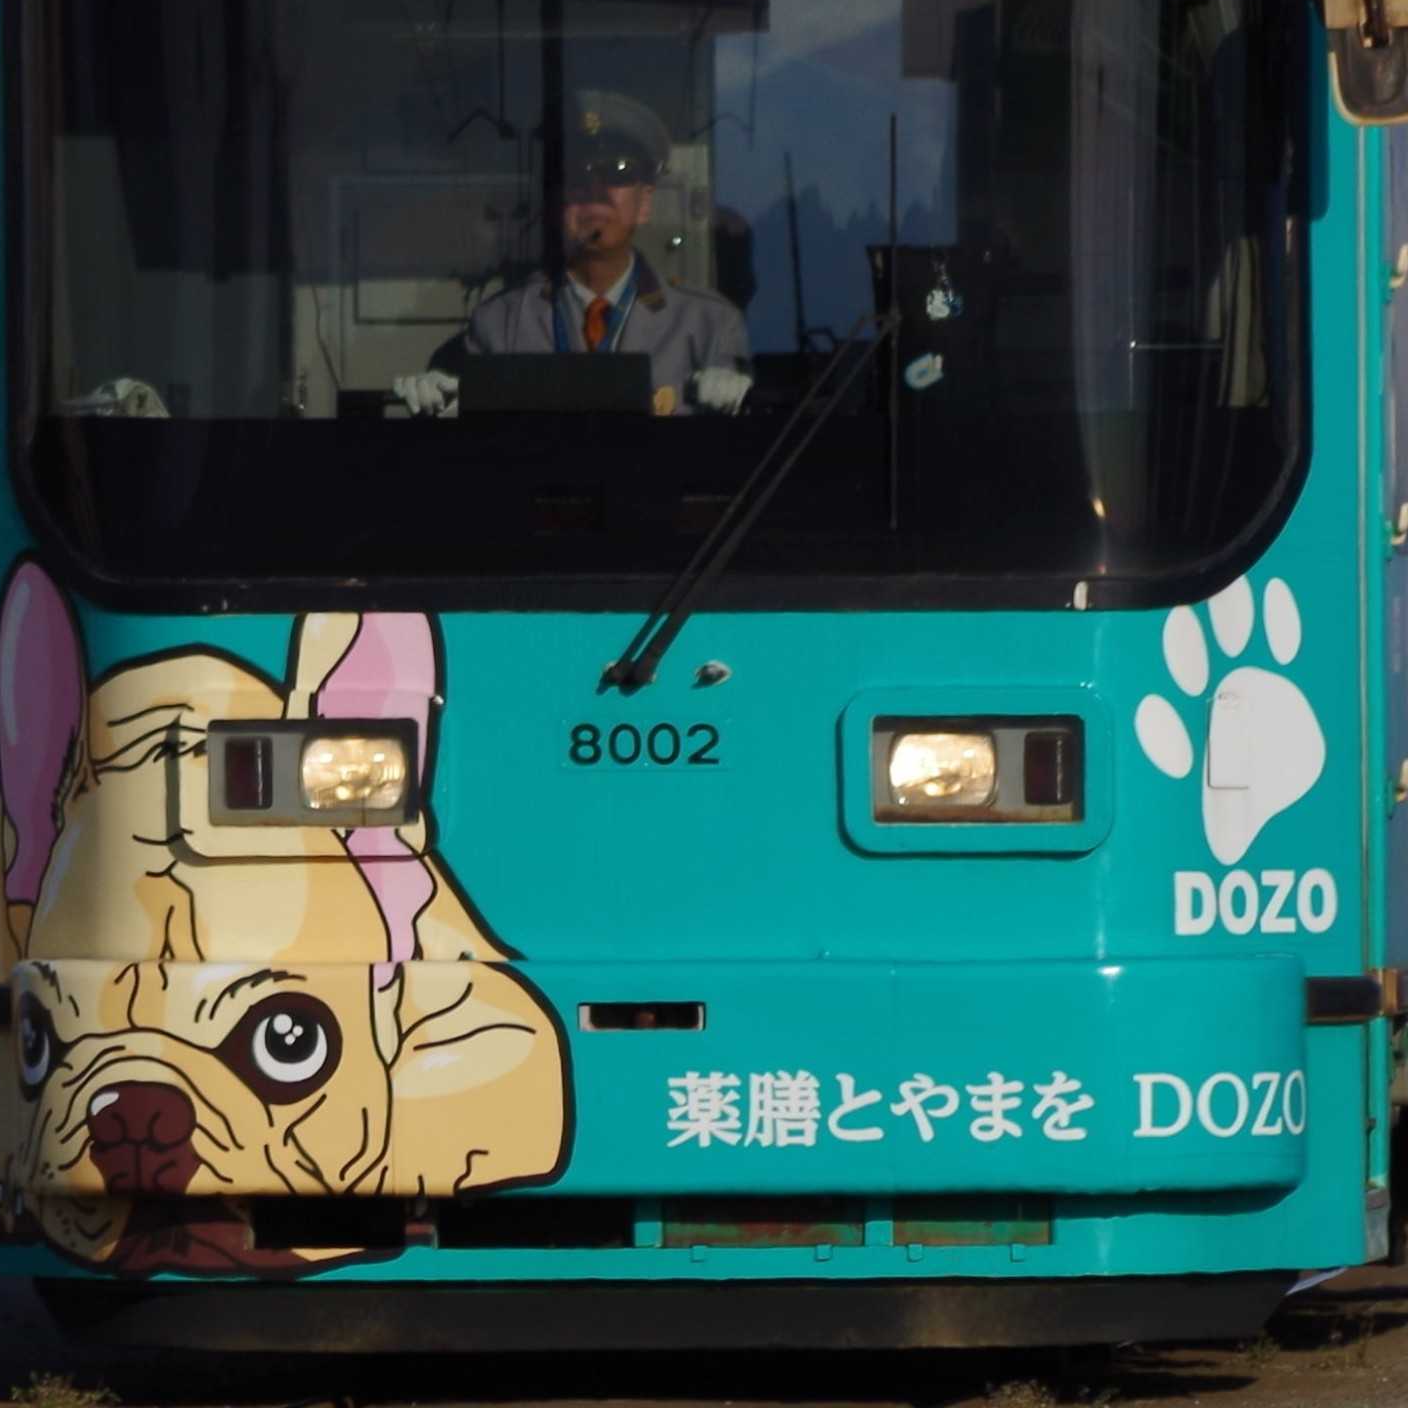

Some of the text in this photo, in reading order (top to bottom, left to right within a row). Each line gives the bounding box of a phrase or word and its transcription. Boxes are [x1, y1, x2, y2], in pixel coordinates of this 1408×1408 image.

[569, 722, 720, 765] 8002
[1174, 867, 1338, 935] DOZO
[666, 1069, 1306, 1148] 薬膳とやまを DOZO
